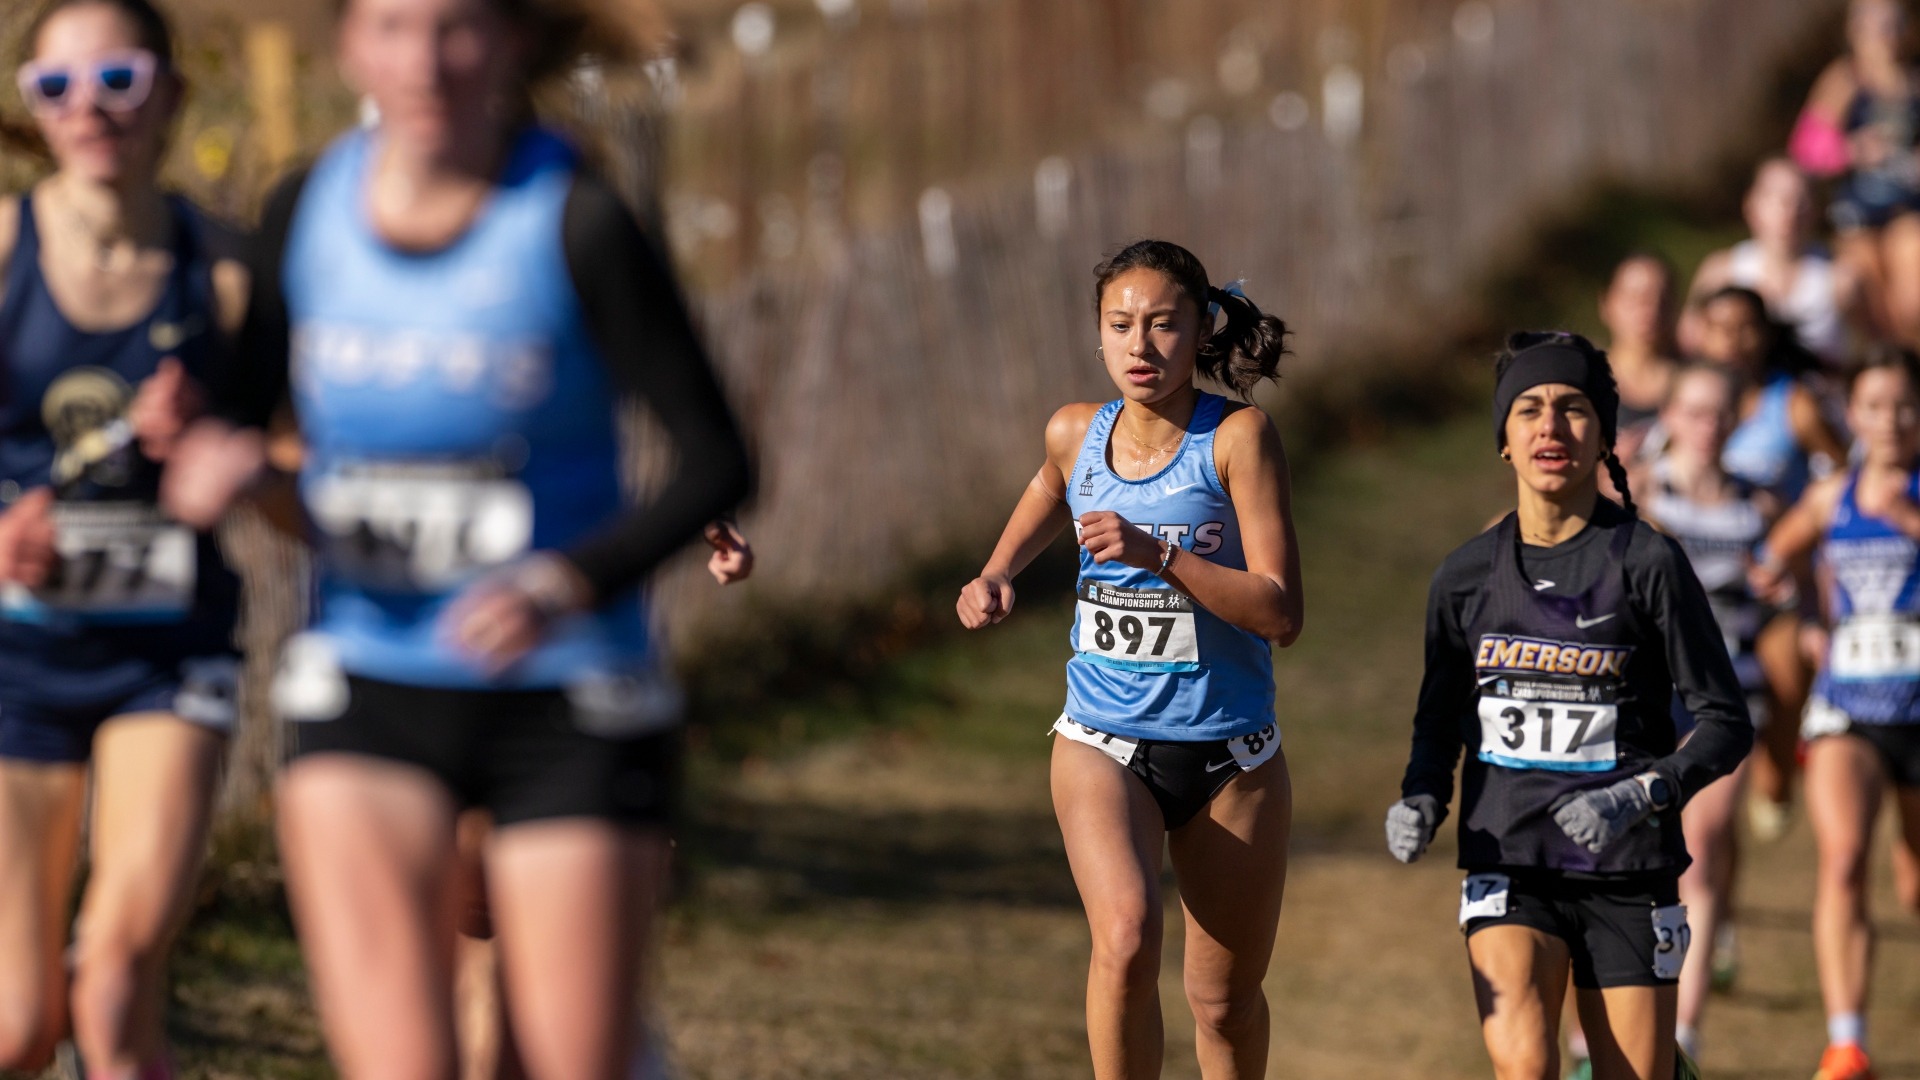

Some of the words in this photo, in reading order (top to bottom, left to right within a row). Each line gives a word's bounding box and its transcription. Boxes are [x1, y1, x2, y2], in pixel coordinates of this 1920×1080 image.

[1100, 594, 1165, 609] CHAMPIONSHIPS
[1094, 610, 1177, 656] 897
[1475, 636, 1630, 677] EMERSON
[1500, 706, 1597, 754] 317
